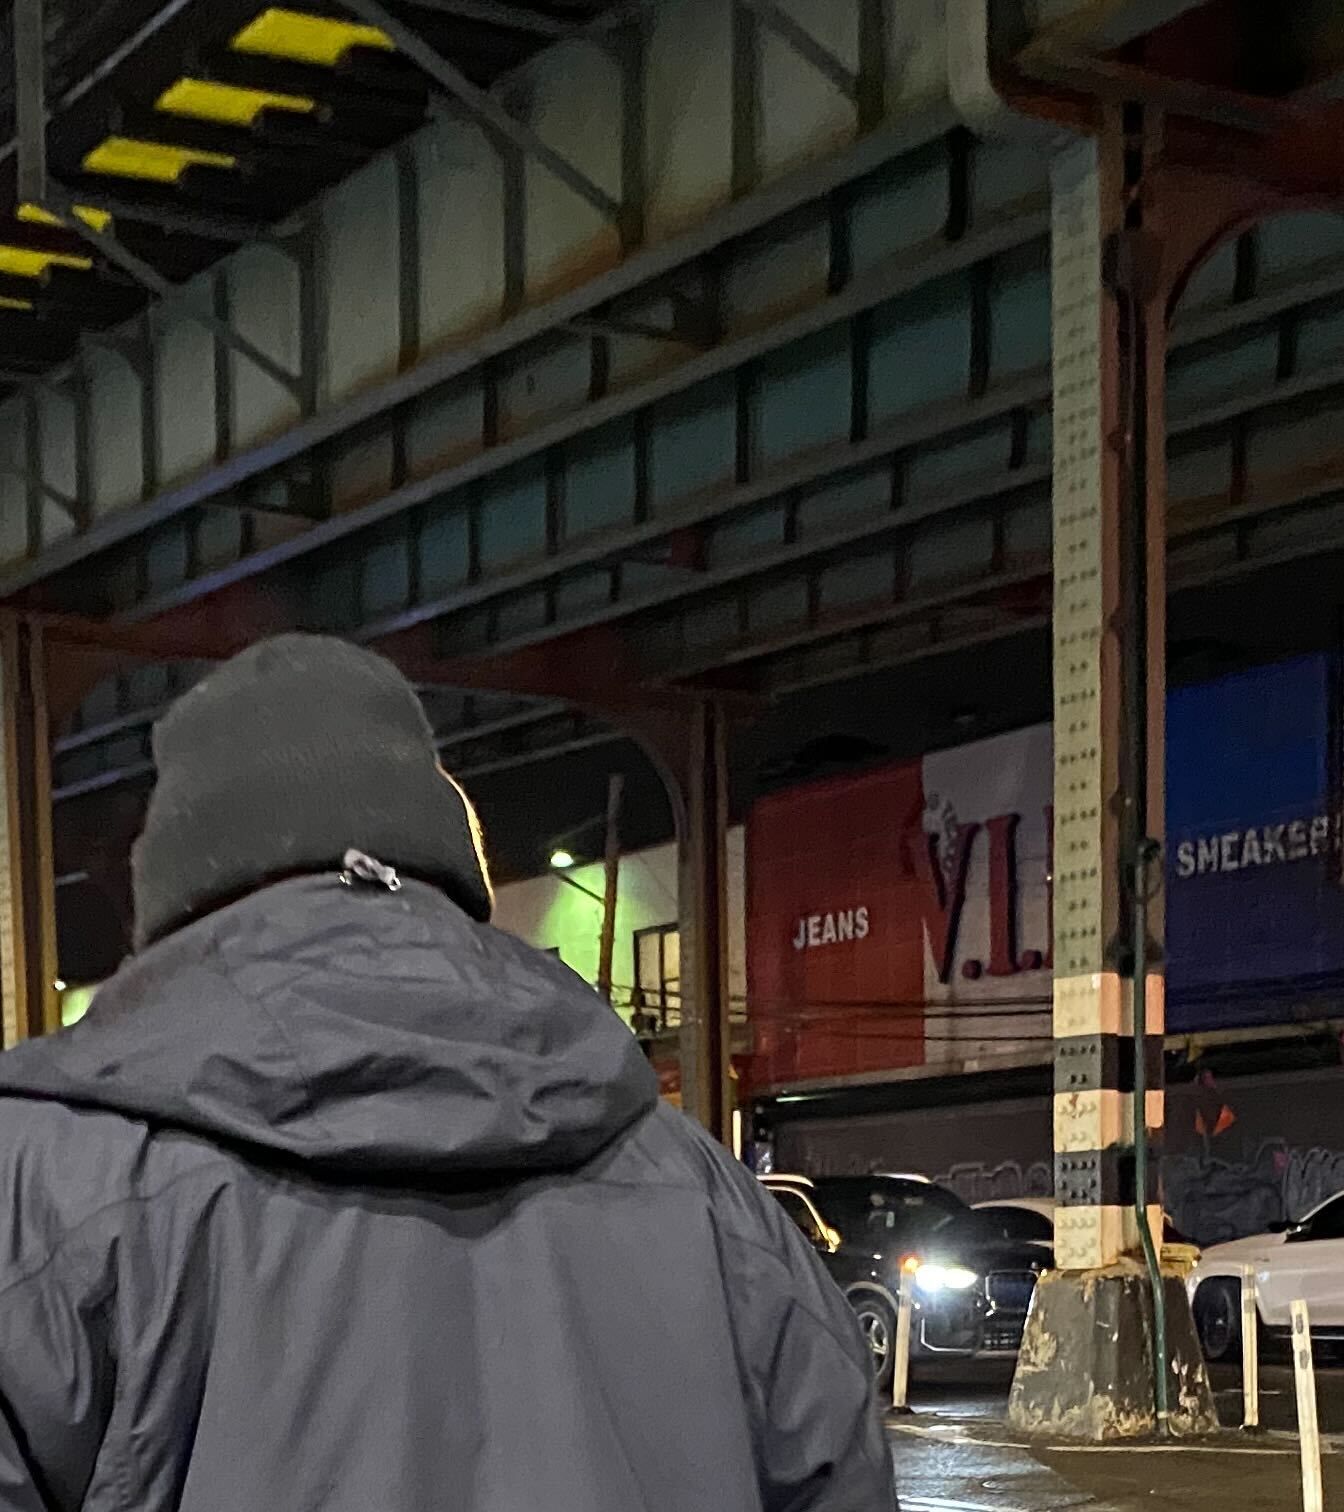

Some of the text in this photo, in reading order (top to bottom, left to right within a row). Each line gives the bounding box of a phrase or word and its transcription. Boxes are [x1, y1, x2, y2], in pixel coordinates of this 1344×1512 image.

[1177, 814, 1343, 877] SNEAKER
[900, 803, 1054, 985] V.I.
[793, 905, 870, 950] JEANS
